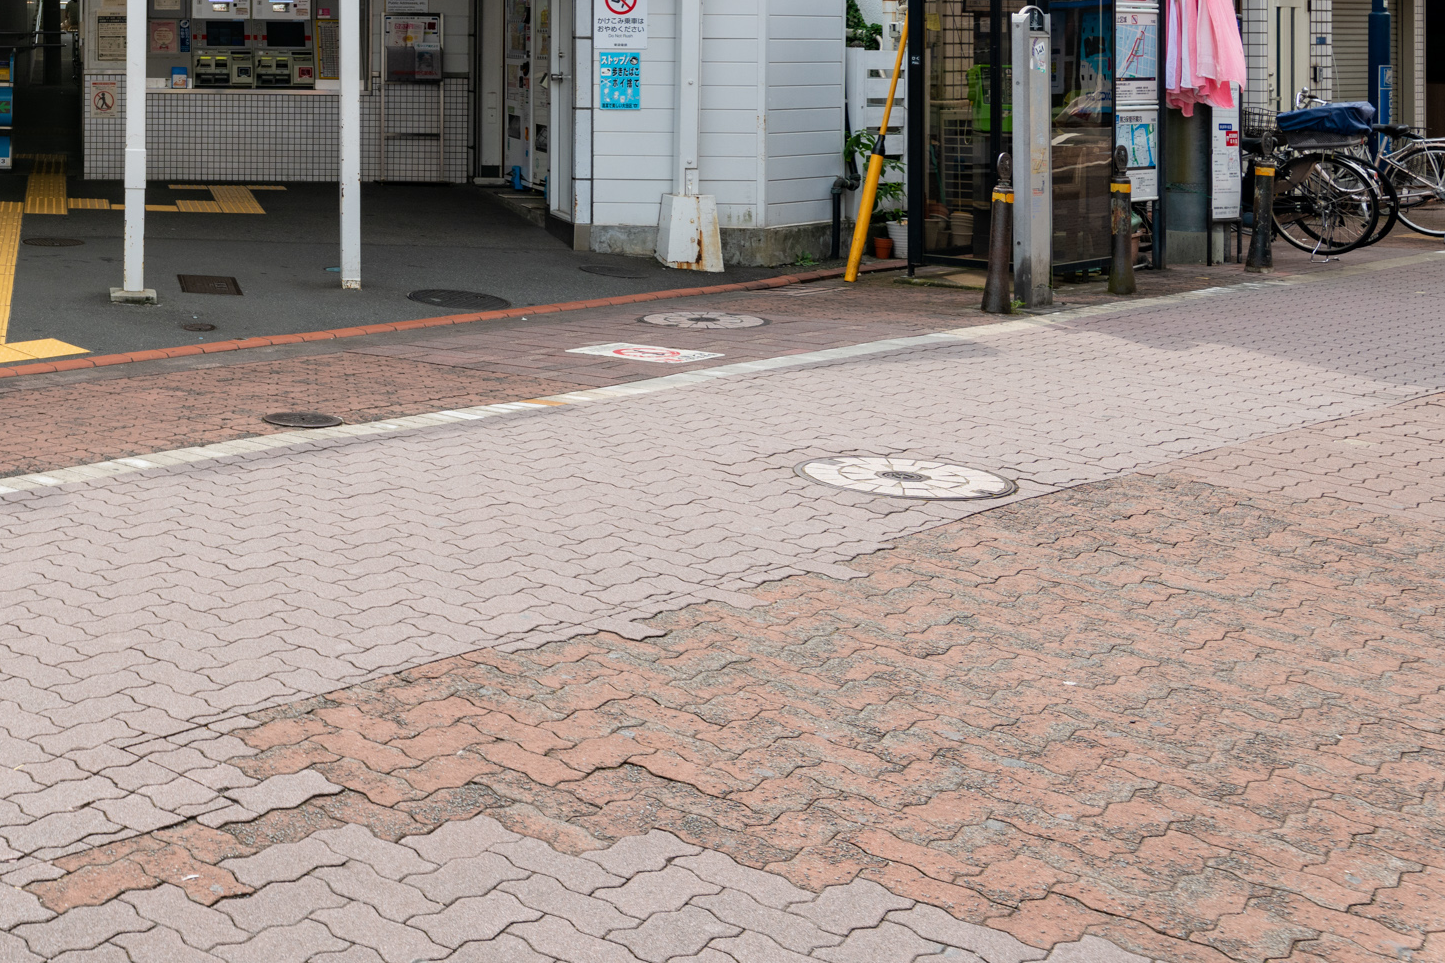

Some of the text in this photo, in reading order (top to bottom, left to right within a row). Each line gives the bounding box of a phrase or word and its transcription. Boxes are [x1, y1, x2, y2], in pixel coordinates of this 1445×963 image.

[597, 17, 645, 25] かけこみ乗車は
[597, 25, 645, 33] おやめください
[612, 77, 640, 88] ポイ捨て
